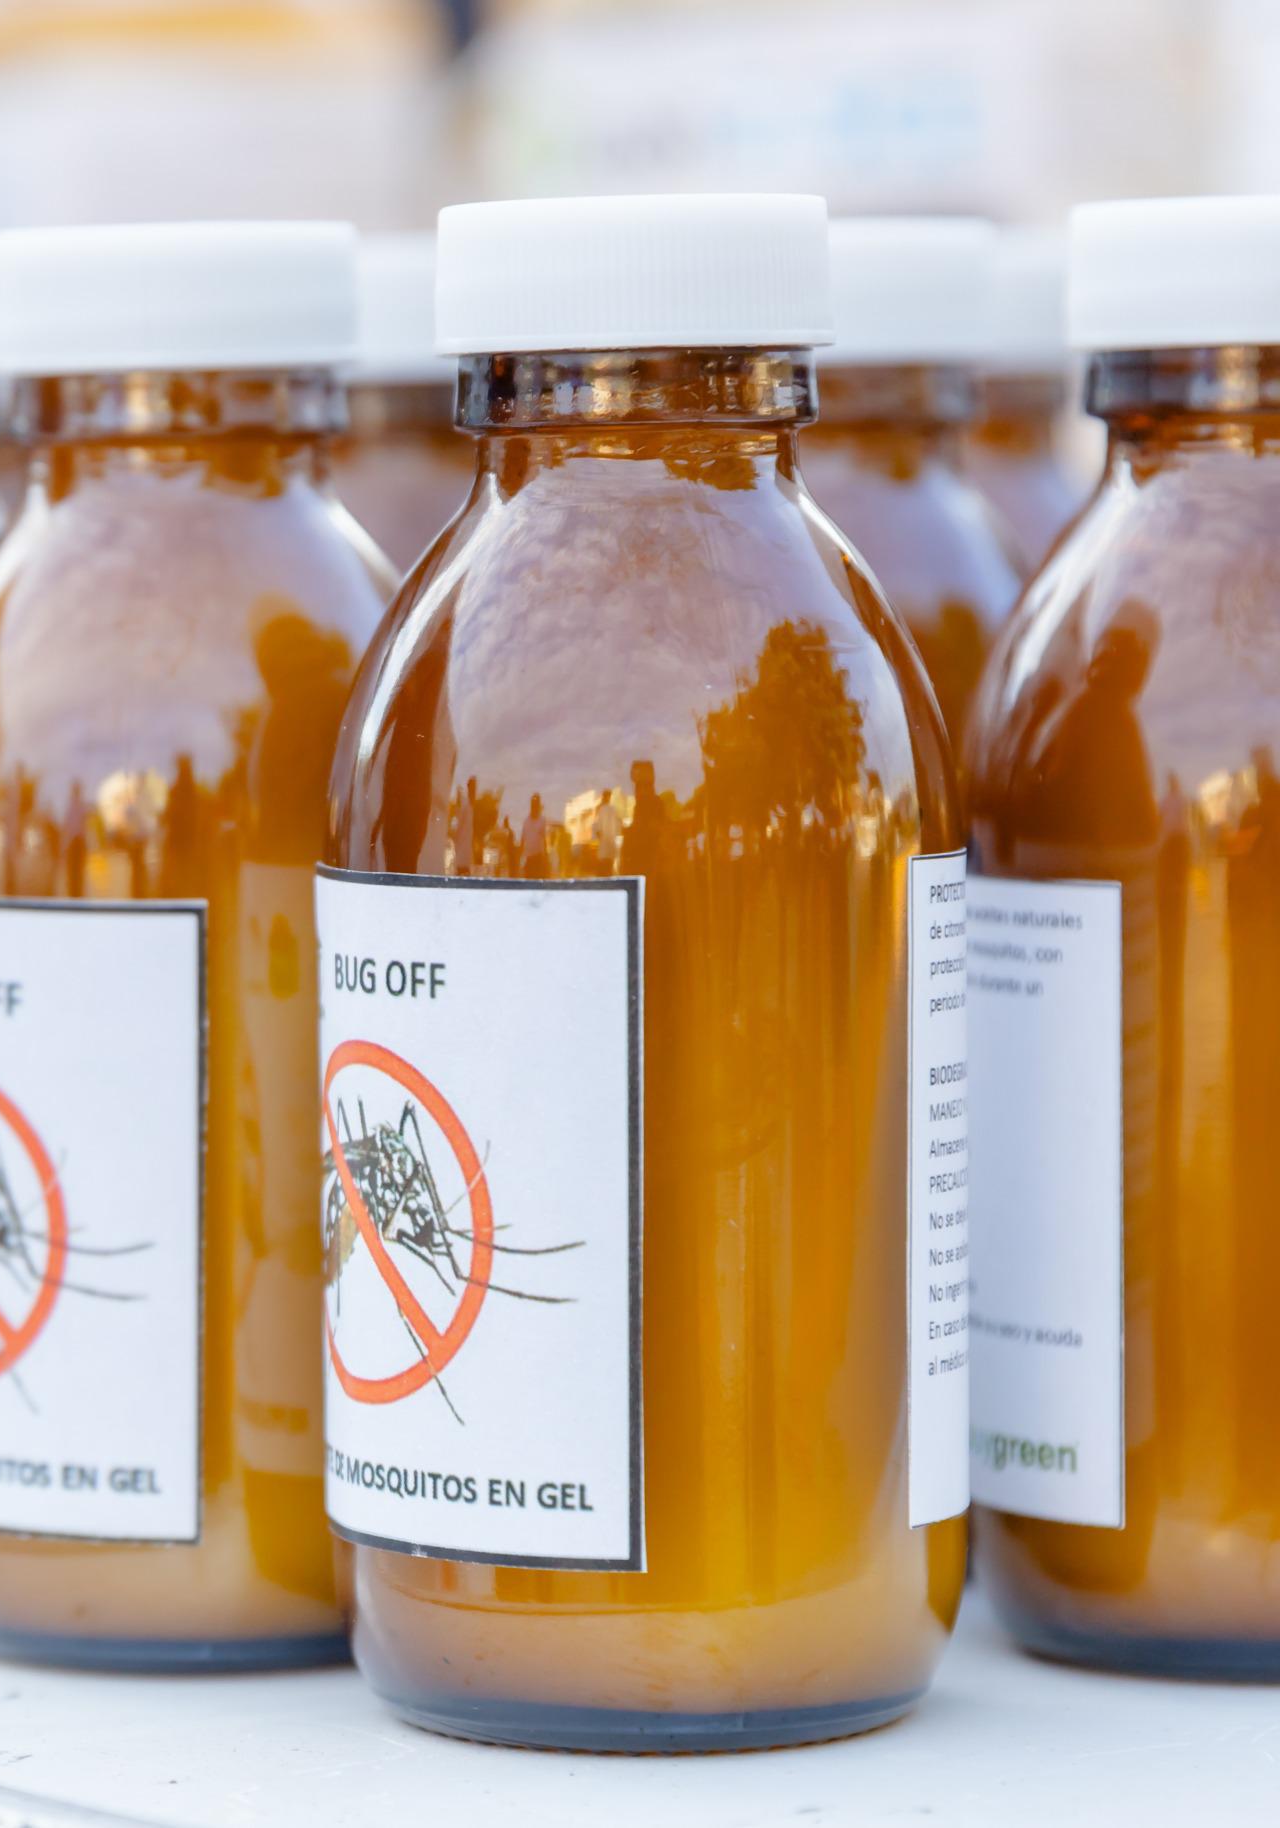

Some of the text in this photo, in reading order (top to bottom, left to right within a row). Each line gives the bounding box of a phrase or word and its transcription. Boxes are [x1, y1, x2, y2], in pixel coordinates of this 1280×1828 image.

[929, 921, 942, 940] de
[335, 953, 446, 999] BUG OFF
[929, 1211, 944, 1231] No
[945, 1212, 955, 1228] se
[929, 1247, 944, 1267] No
[945, 1248, 955, 1265] se
[929, 1284, 944, 1304] No
[928, 1320, 942, 1341] En
[928, 1356, 938, 1377] al
[61, 1464, 97, 1491] EN
[109, 1467, 161, 1494] GEL
[346, 1458, 478, 1504] MOSQUITOS
[488, 1478, 526, 1507] EN
[537, 1482, 594, 1511] GEL
